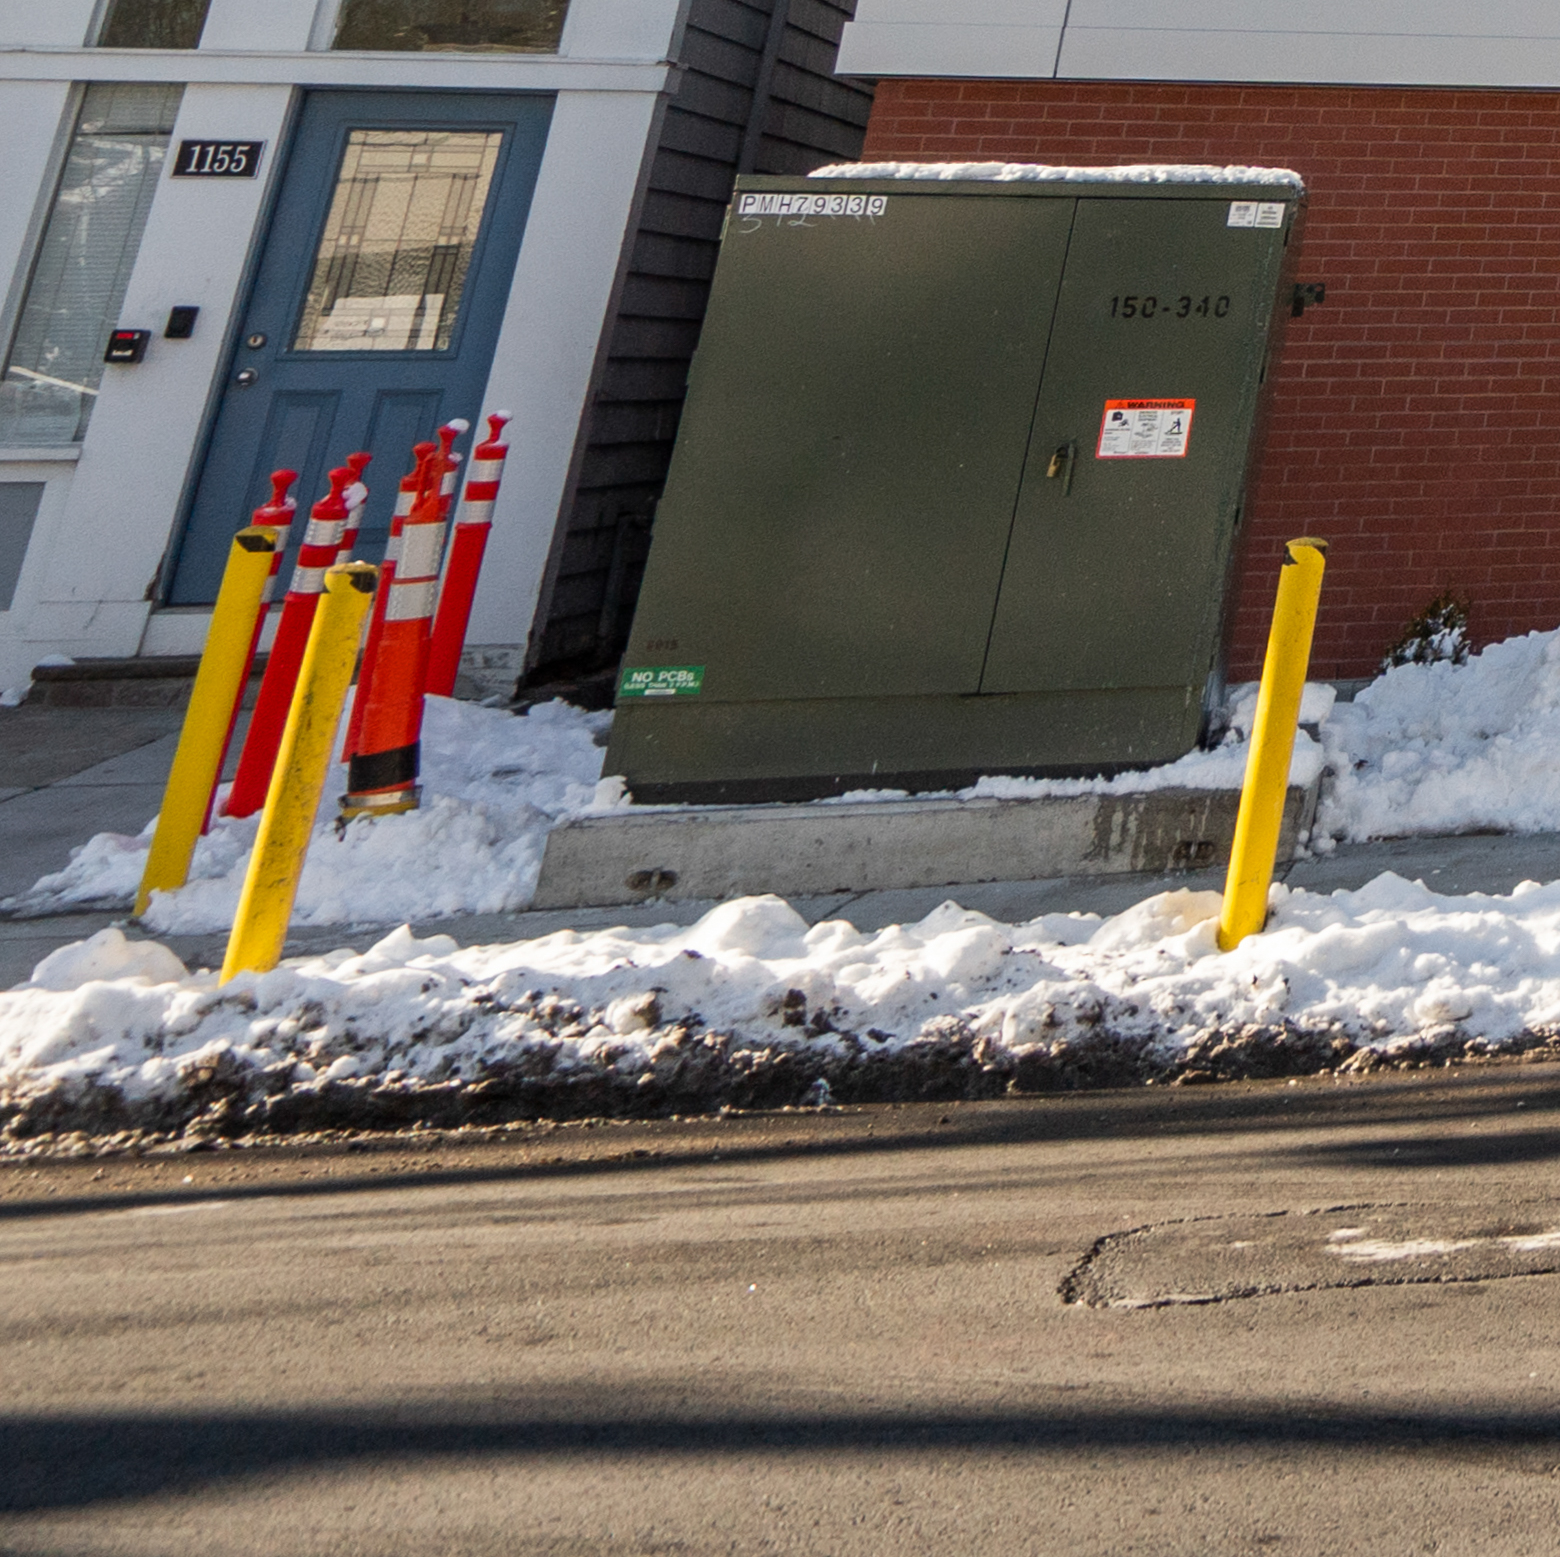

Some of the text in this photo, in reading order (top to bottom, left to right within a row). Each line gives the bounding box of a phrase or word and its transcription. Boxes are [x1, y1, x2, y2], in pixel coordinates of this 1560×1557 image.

[185, 145, 251, 173] 1155
[742, 195, 884, 216] PMH79339
[1110, 295, 1230, 319] 150-340
[1127, 401, 1185, 409] WARNING
[632, 670, 694, 682] NO PCBs
